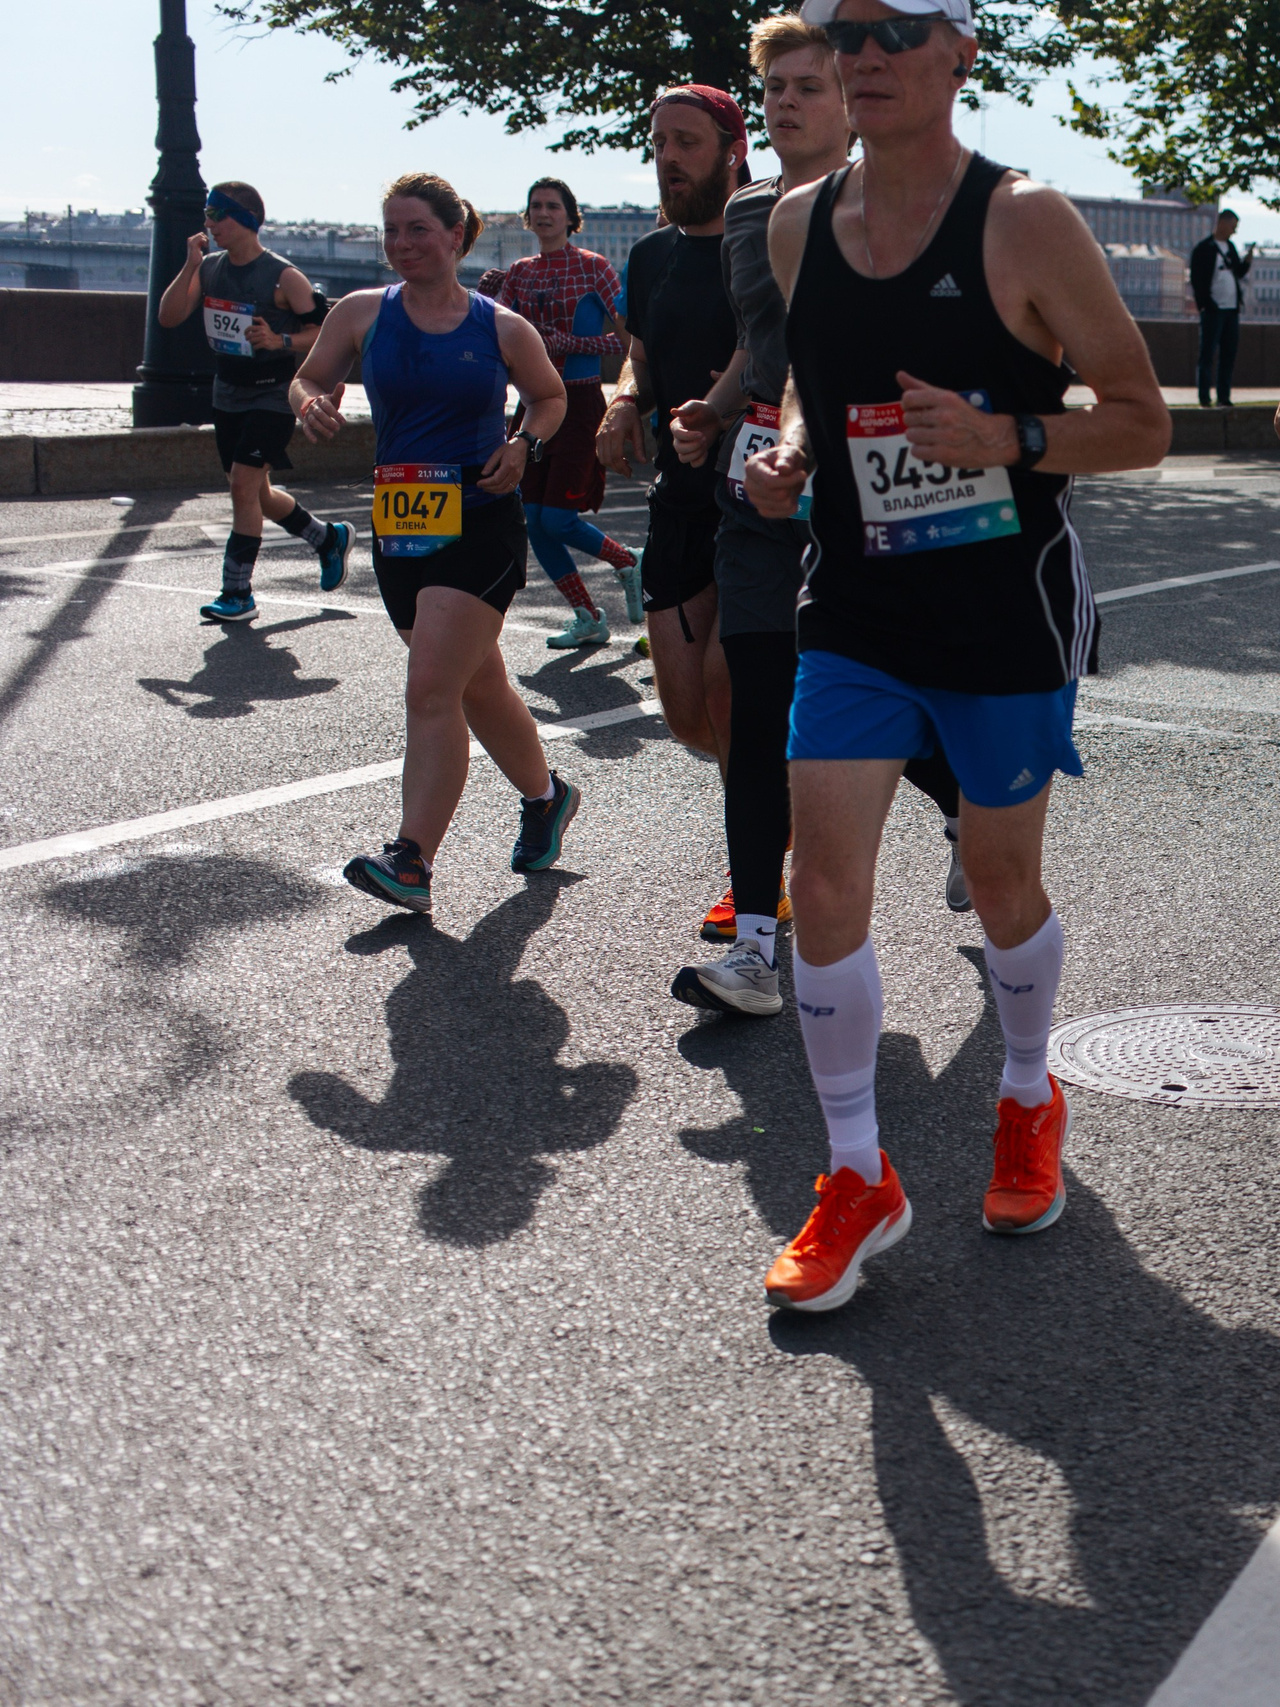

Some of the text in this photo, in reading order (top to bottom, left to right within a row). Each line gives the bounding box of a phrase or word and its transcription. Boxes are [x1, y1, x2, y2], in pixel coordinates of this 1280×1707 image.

[929, 289, 963, 298] adidas
[213, 313, 241, 334] 594
[859, 416, 899, 428] МАРАФОН
[418, 470, 432, 478] 21,1
[381, 490, 449, 519] 1047
[883, 484, 976, 513] ВЛАДИСЛАВ
[395, 521, 427, 530] ЕЛЕНА
[398, 872, 420, 885] HOKA
